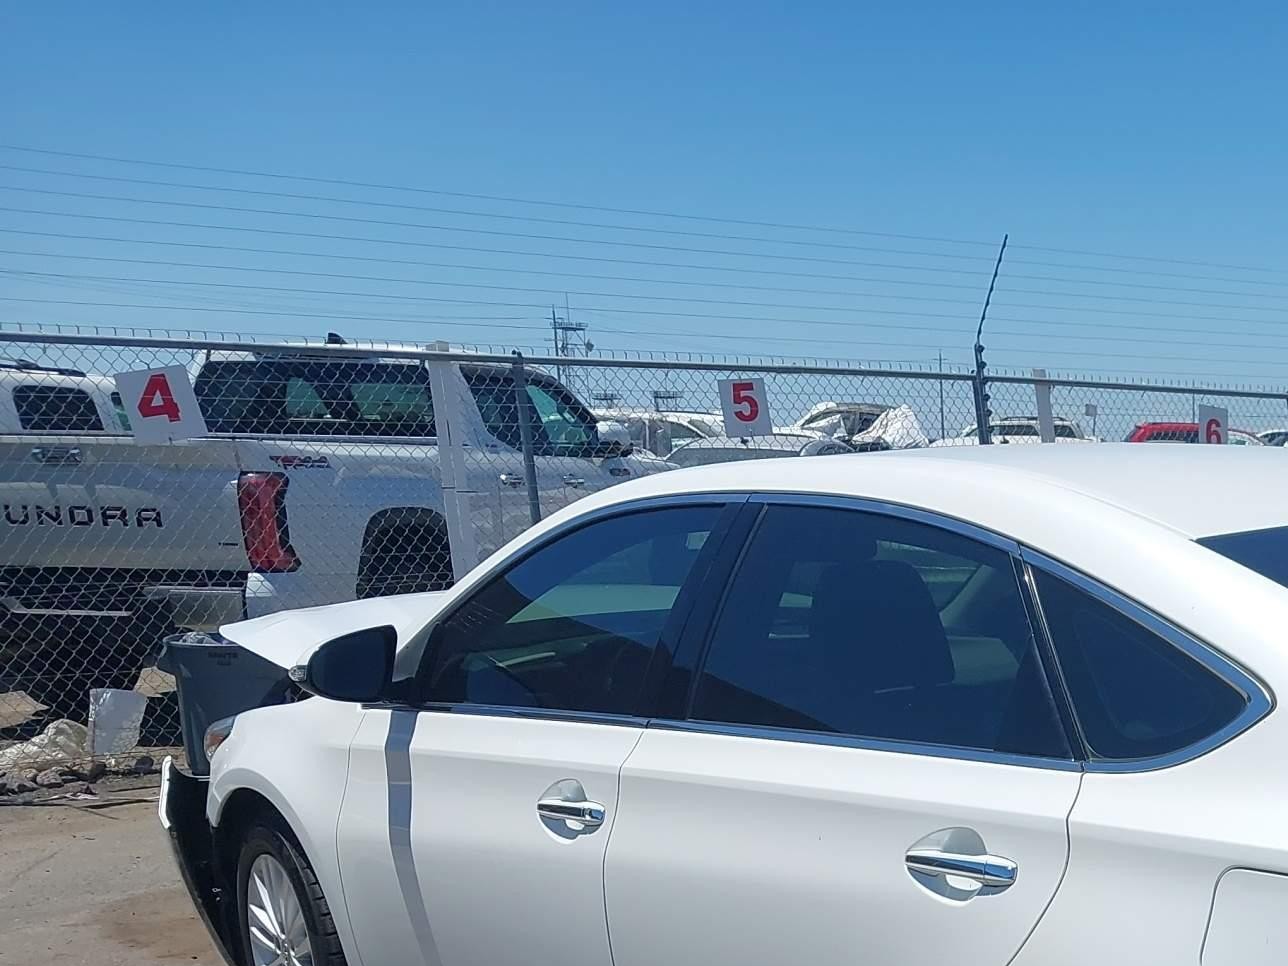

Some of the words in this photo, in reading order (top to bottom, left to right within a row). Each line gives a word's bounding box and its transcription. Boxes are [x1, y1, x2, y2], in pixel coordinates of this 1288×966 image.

[137, 373, 181, 422] 4
[732, 382, 759, 422] 5
[1206, 418, 1222, 444] 6
